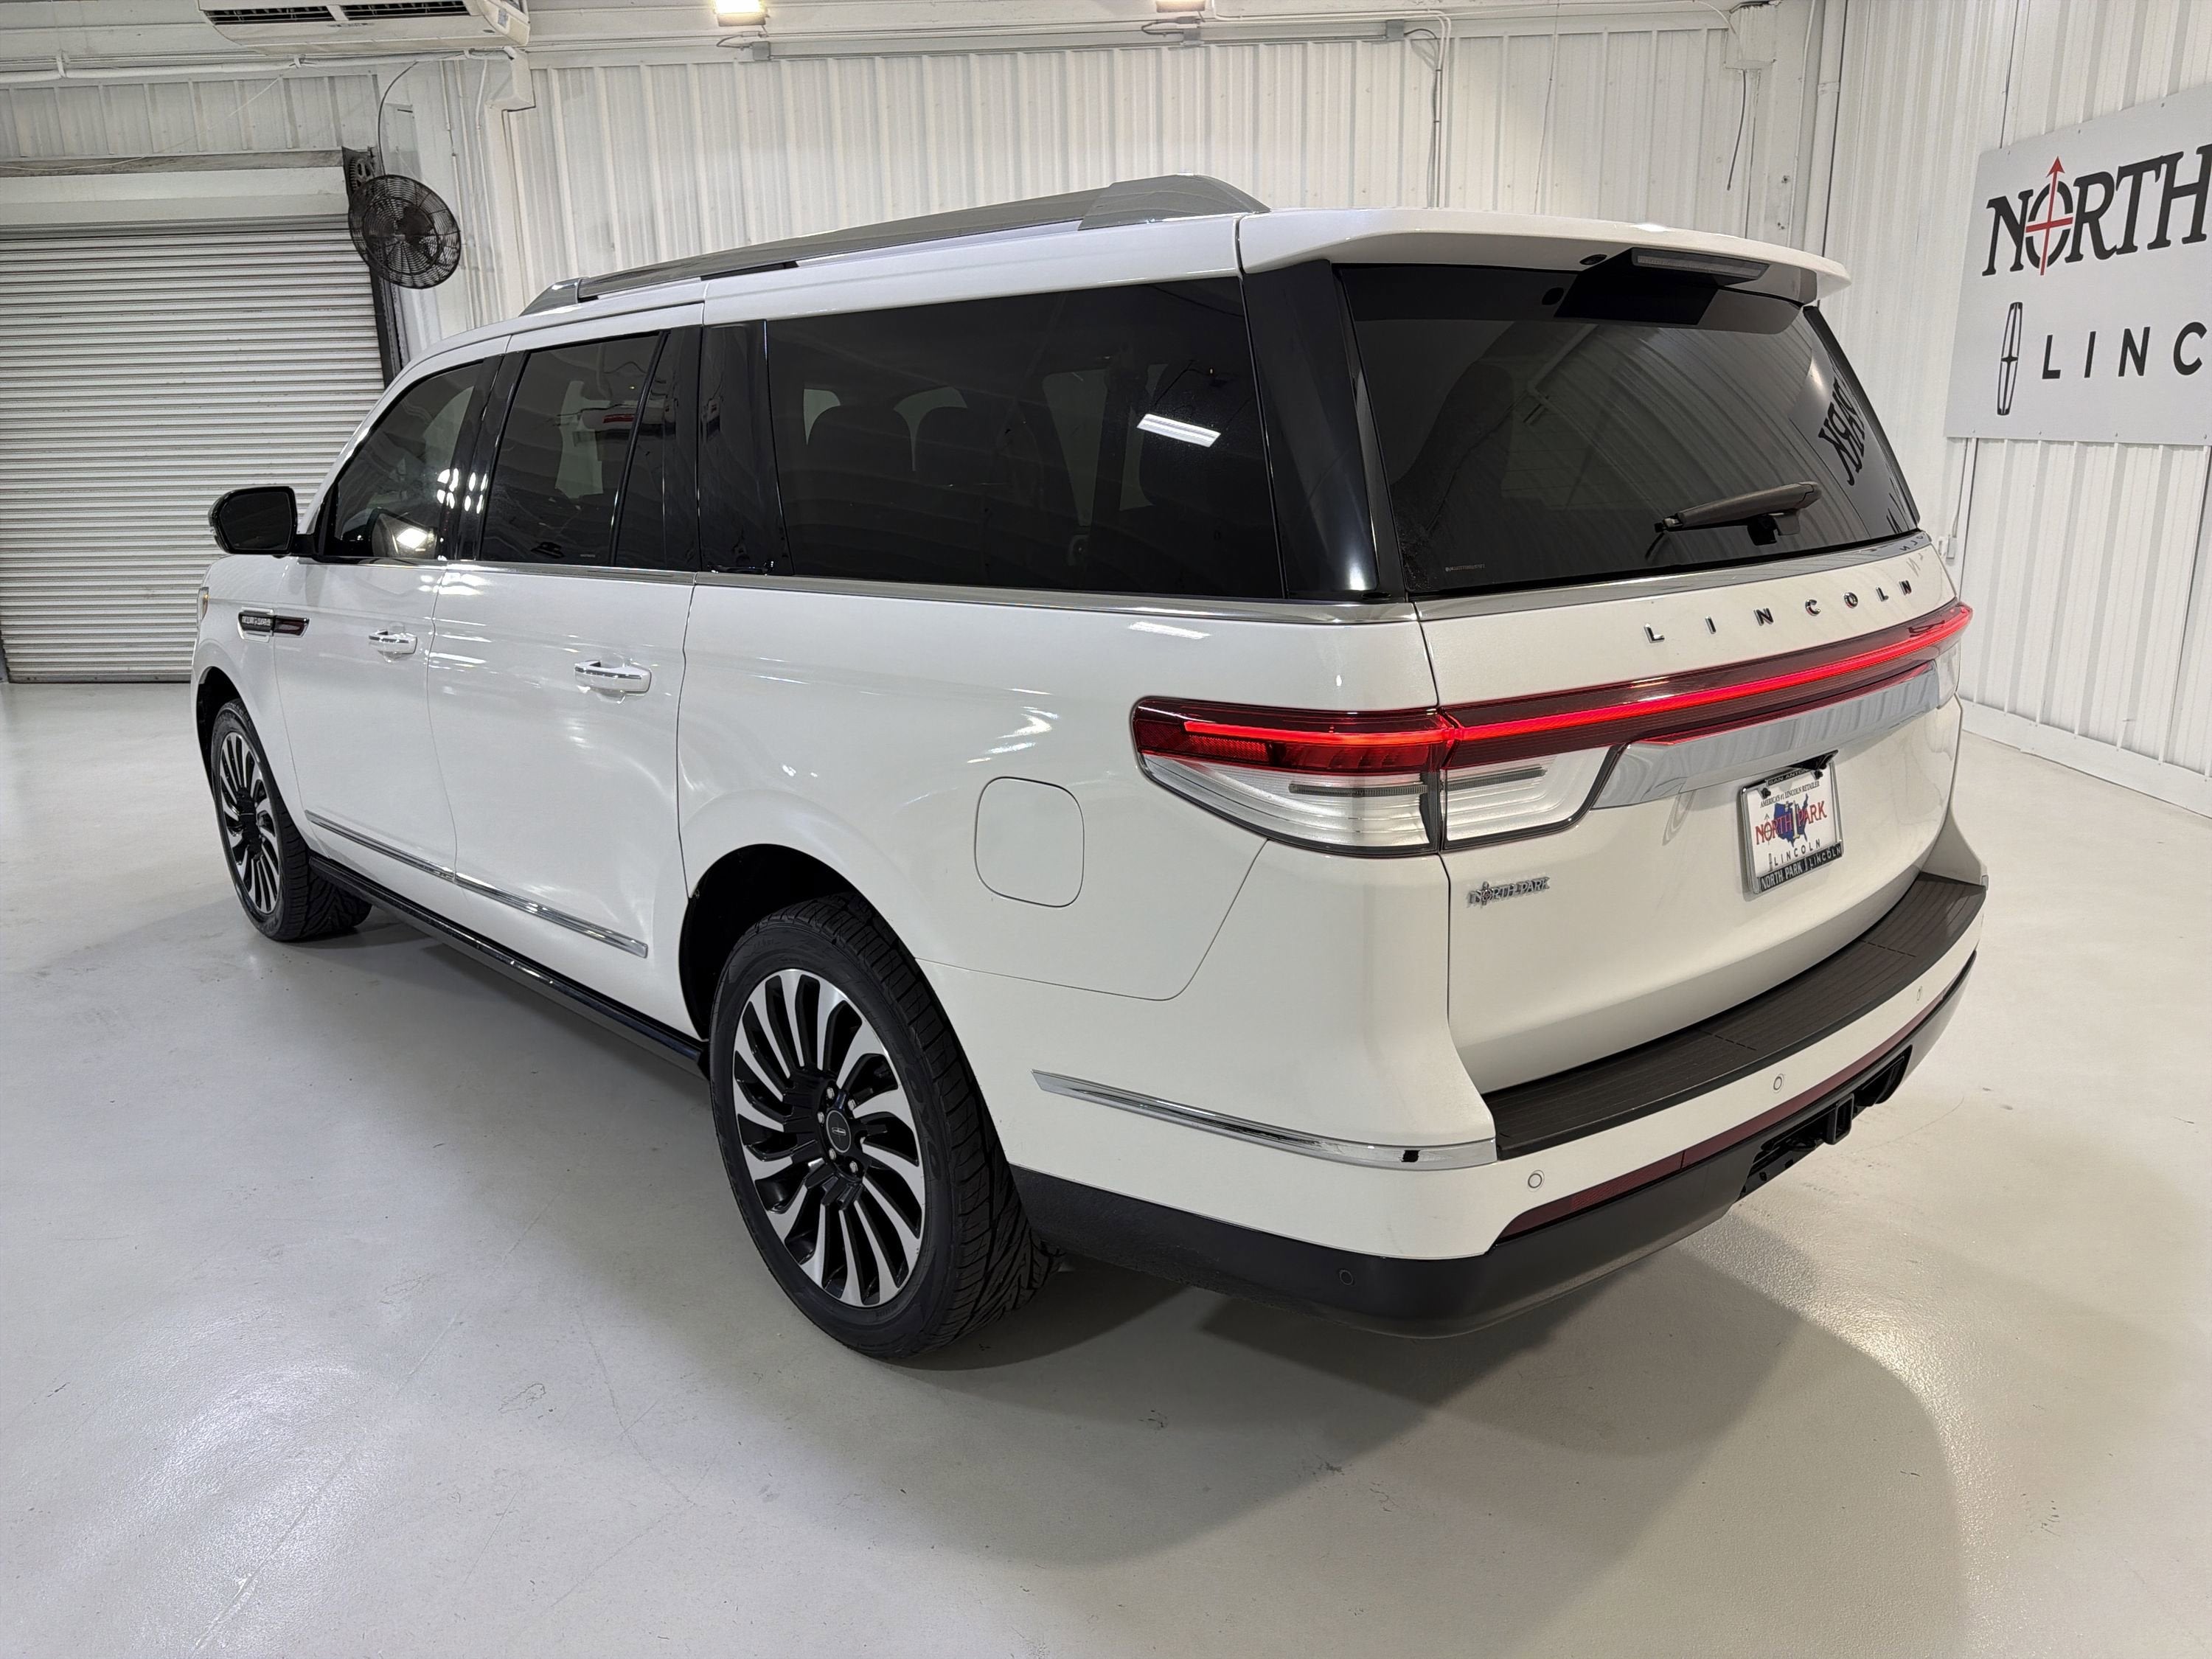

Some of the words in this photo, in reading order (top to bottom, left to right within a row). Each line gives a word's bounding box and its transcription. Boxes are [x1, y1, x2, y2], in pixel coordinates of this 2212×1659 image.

[1982, 143, 2212, 277] NORTH
[1644, 580, 1913, 644] LINCOLN
[1784, 786, 1802, 799] LINCOLN
[1802, 781, 1820, 792] RETAILER
[1785, 768, 1809, 779] ANTON
[1755, 813, 1792, 845] NORTH
[1797, 801, 1828, 827] PARK
[1761, 870, 1784, 890] NORTH
[1784, 862, 1804, 880] PARK
[1809, 846, 1842, 868] LINCOLN
[1773, 839, 1820, 866] LINCOLN
[1467, 883, 1515, 907] NORTH
[1519, 877, 1550, 896] PARK
